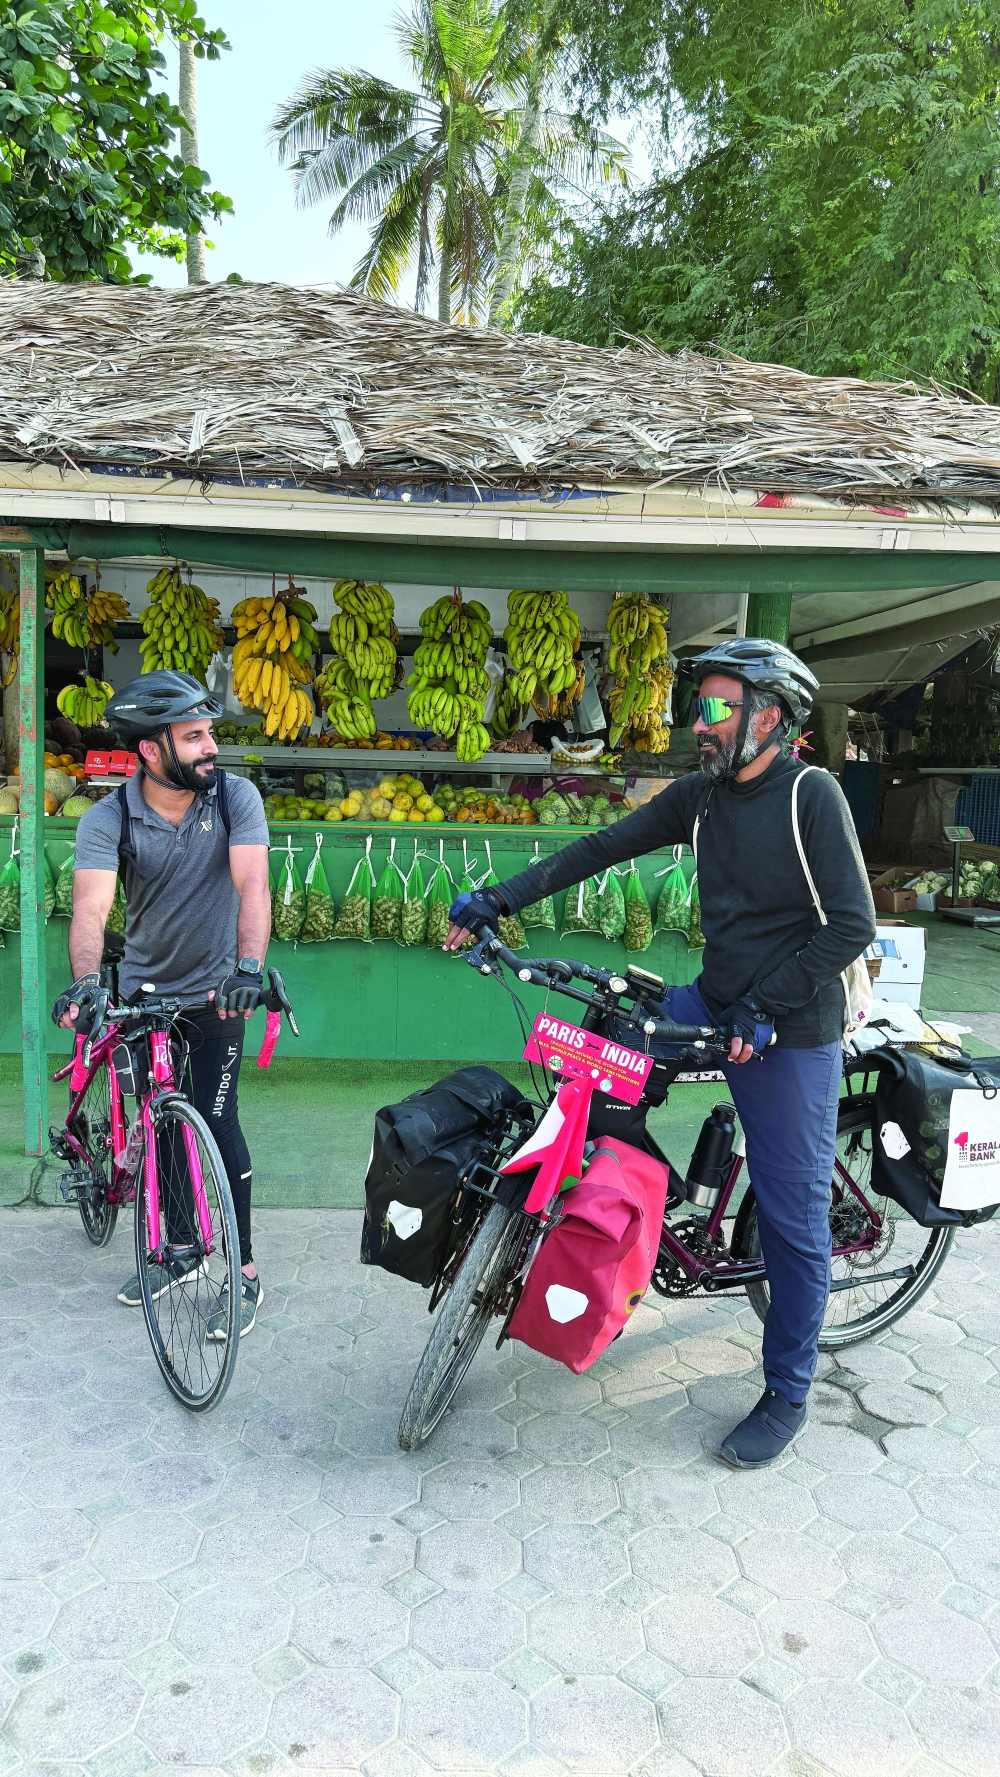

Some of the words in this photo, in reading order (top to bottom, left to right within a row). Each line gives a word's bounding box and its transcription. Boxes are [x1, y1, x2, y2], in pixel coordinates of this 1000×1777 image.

[537, 1016, 587, 1049] PARIS
[601, 1043, 647, 1075] INDIA
[549, 1045, 567, 1055] WORLD
[585, 1060, 602, 1070] WORLD
[574, 1050, 593, 1060] AROUND
[601, 1061, 618, 1070] WORLD
[969, 1150, 996, 1162] BANK
